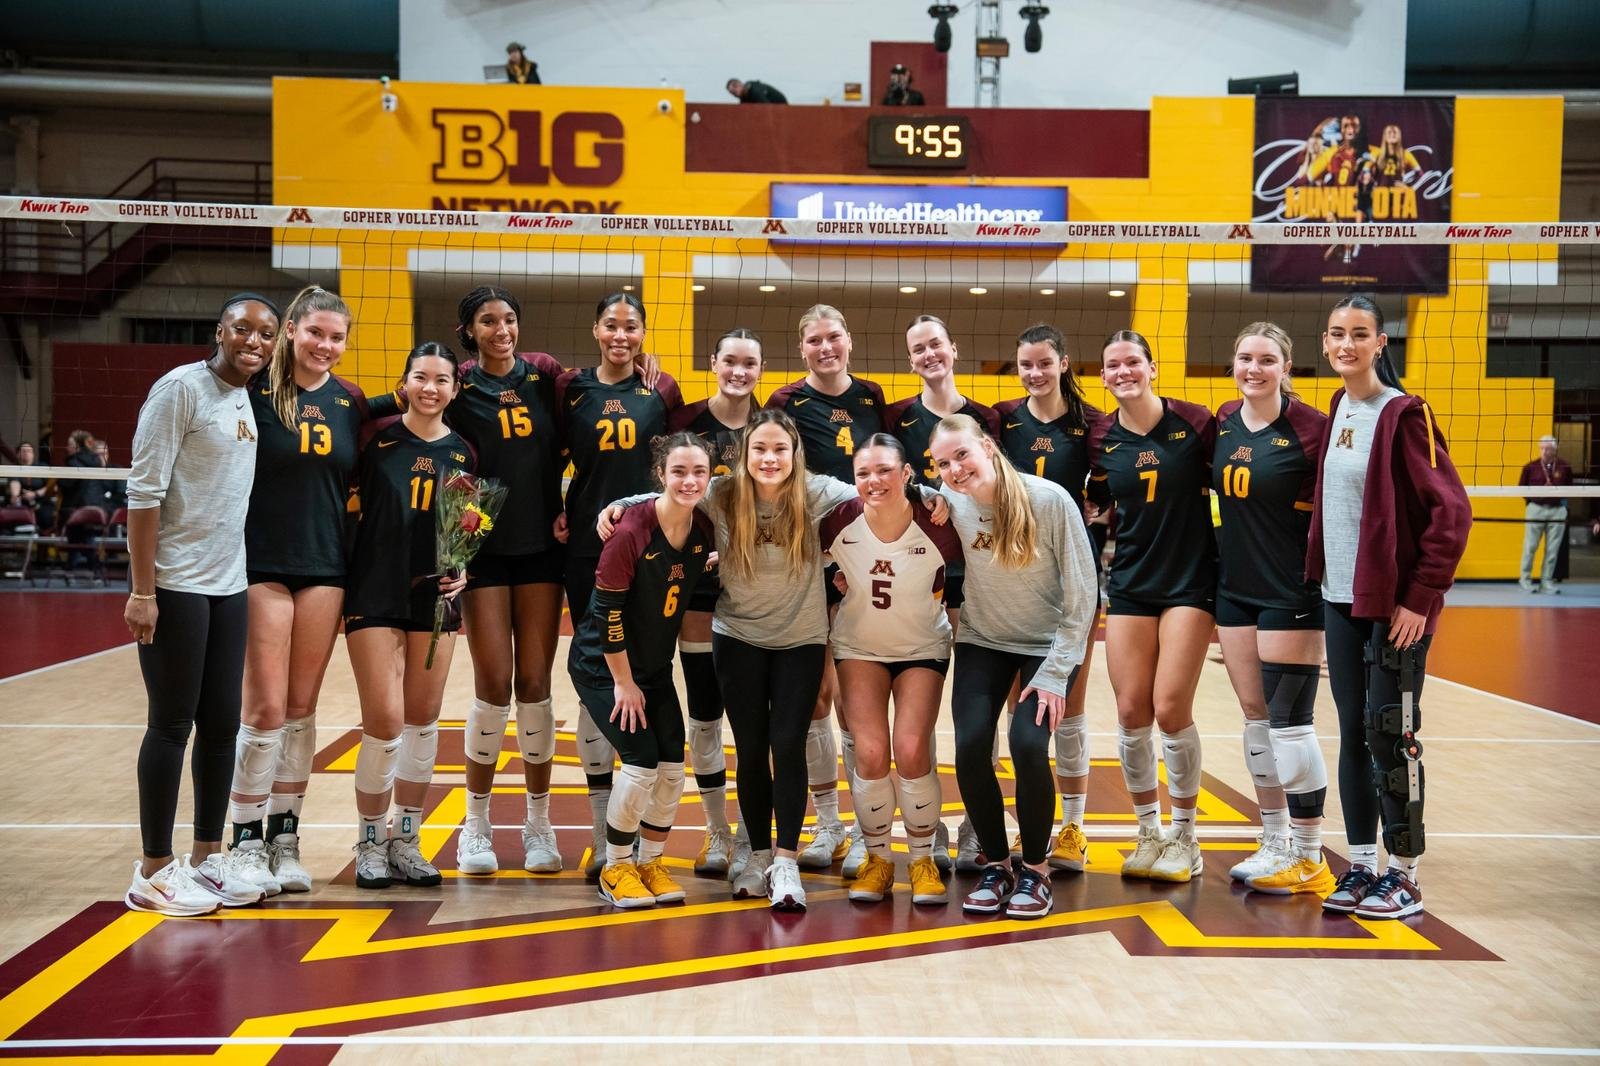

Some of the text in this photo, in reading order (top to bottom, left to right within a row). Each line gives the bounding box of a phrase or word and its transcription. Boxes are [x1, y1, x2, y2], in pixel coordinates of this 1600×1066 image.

[895, 124, 962, 158] 9:55
[119, 203, 258, 220] GOPHER VOLLEYBALL
[343, 210, 479, 226] GOPHER VOLLEYBALL
[601, 217, 734, 232] GOPHER VOLLEYBALL
[816, 221, 948, 236] GOPHER VOLLEYBALL
[1068, 224, 1201, 237] GOPHER VOLLEYBALL
[1283, 225, 1417, 238] GOPHER VOLLEYBALL
[1540, 225, 1589, 238] GOPHER
[498, 406, 533, 439] 15
[596, 418, 636, 450] 20
[299, 423, 332, 455] 13
[835, 426, 854, 455] 4
[1034, 455, 1045, 477] 1
[410, 476, 434, 511] 11
[1139, 470, 1158, 502] 7
[1222, 464, 1251, 499] 10
[663, 584, 680, 618] 6
[871, 580, 893, 610] 5
